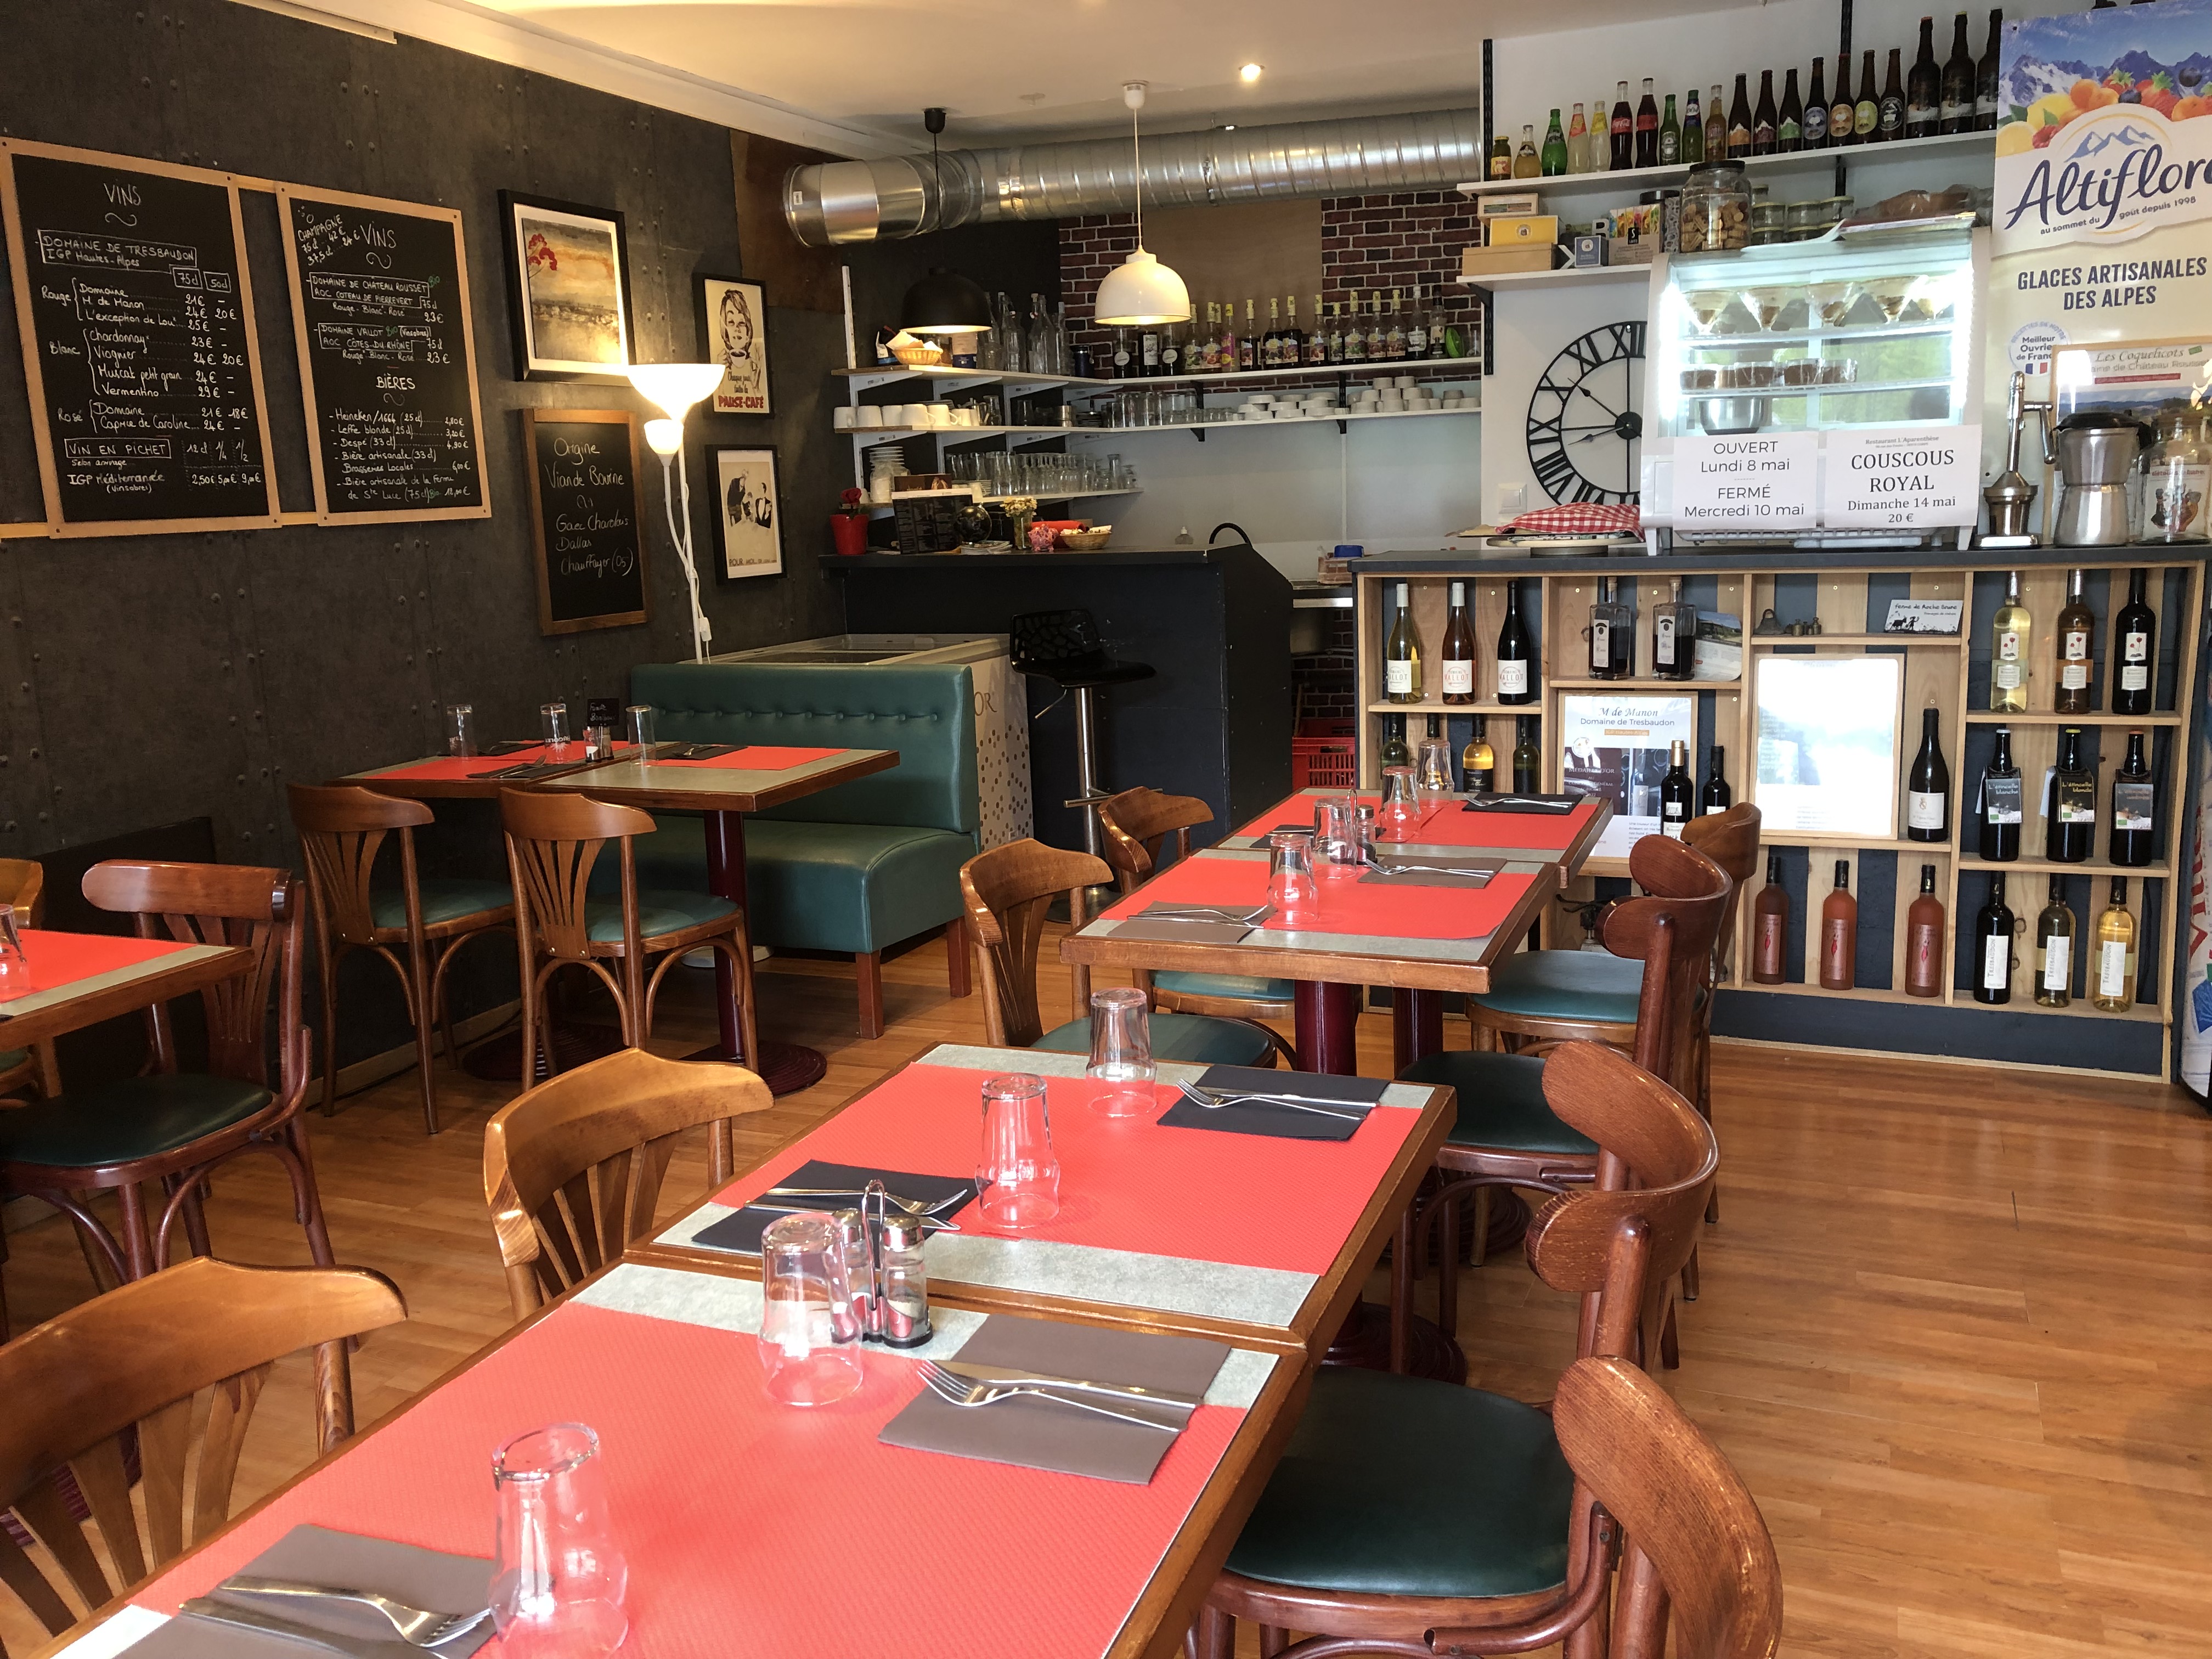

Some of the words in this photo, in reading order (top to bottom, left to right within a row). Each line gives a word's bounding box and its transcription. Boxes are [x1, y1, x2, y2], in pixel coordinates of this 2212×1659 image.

[104, 179, 141, 206] VINS
[2053, 220, 2086, 232] sommet
[2142, 202, 2170, 215] depuis
[2175, 196, 2196, 206] 1998
[297, 215, 343, 241] CHAMPAGNE
[360, 221, 396, 248] VINS
[47, 250, 71, 259] IGP
[108, 243, 120, 252] DE
[126, 245, 194, 261] TRESBAUDON
[2018, 268, 2081, 290] GLACES
[2087, 257, 2207, 284] ARTISANALES
[349, 280, 359, 288] DE
[42, 285, 71, 302] Rouge
[315, 287, 331, 297] AOC
[363, 294, 371, 302] DE
[2064, 291, 2096, 310] DES
[2102, 286, 2156, 307] ALPES
[98, 297, 109, 306] de
[185, 308, 207, 318] 24€
[215, 309, 236, 319] 20€
[143, 314, 155, 324] de
[188, 320, 210, 331] 25€
[424, 312, 444, 323] 23€
[50, 342, 80, 354] Blanc
[191, 337, 213, 348] 23€
[323, 337, 340, 346] AOC
[2021, 343, 2052, 352] Ouvrie
[94, 347, 136, 369] Viognier
[194, 353, 216, 364] 24€
[222, 354, 244, 365] 20€
[2095, 353, 2115, 362] Les
[2119, 347, 2185, 363] Coquelicots
[98, 365, 135, 379] Muscat
[196, 372, 217, 383] 24€
[376, 373, 415, 390] BIÈRES
[101, 383, 159, 397] Vermentino
[198, 387, 221, 398] 29€
[718, 396, 764, 408] PAUSE-CAFÉ
[58, 408, 83, 422] Rosé
[139, 419, 150, 427] de
[153, 415, 190, 429] Caroline
[204, 421, 224, 430] 24€
[338, 424, 360, 433] Leffe
[365, 425, 391, 435] blonde
[70, 444, 90, 455] VIN
[100, 445, 116, 454] EN
[126, 445, 165, 454] PICHET
[342, 450, 365, 460] Bière
[369, 449, 411, 460] artisanale
[554, 438, 600, 465] Origine
[1714, 441, 1778, 454] OUVERT
[1701, 460, 1742, 472] Lundi
[1747, 460, 1755, 471] 8
[1762, 459, 1790, 471] mai
[1851, 450, 1954, 469] COUSCOUS
[67, 475, 93, 484] IGP
[345, 478, 367, 486] Bière
[370, 477, 407, 486] artisanale
[423, 476, 431, 484] la
[544, 461, 584, 488] Viande
[589, 465, 624, 486] Bovine
[1870, 475, 1934, 492] ROYAL
[348, 491, 358, 499] de
[383, 490, 401, 500] Luce
[1718, 484, 1770, 498] FERMÉ
[1685, 504, 1750, 517] Mercredi
[1755, 504, 1770, 516] 10
[1776, 504, 1804, 515] mai
[1848, 499, 1909, 511] Dimanche
[1914, 498, 1929, 508] 14
[1933, 497, 1956, 507] mai
[1888, 514, 1903, 523] 20
[1905, 514, 1914, 522] €
[556, 537, 591, 551] Dallas
[1598, 708, 1609, 716] M
[1612, 707, 1622, 716] de
